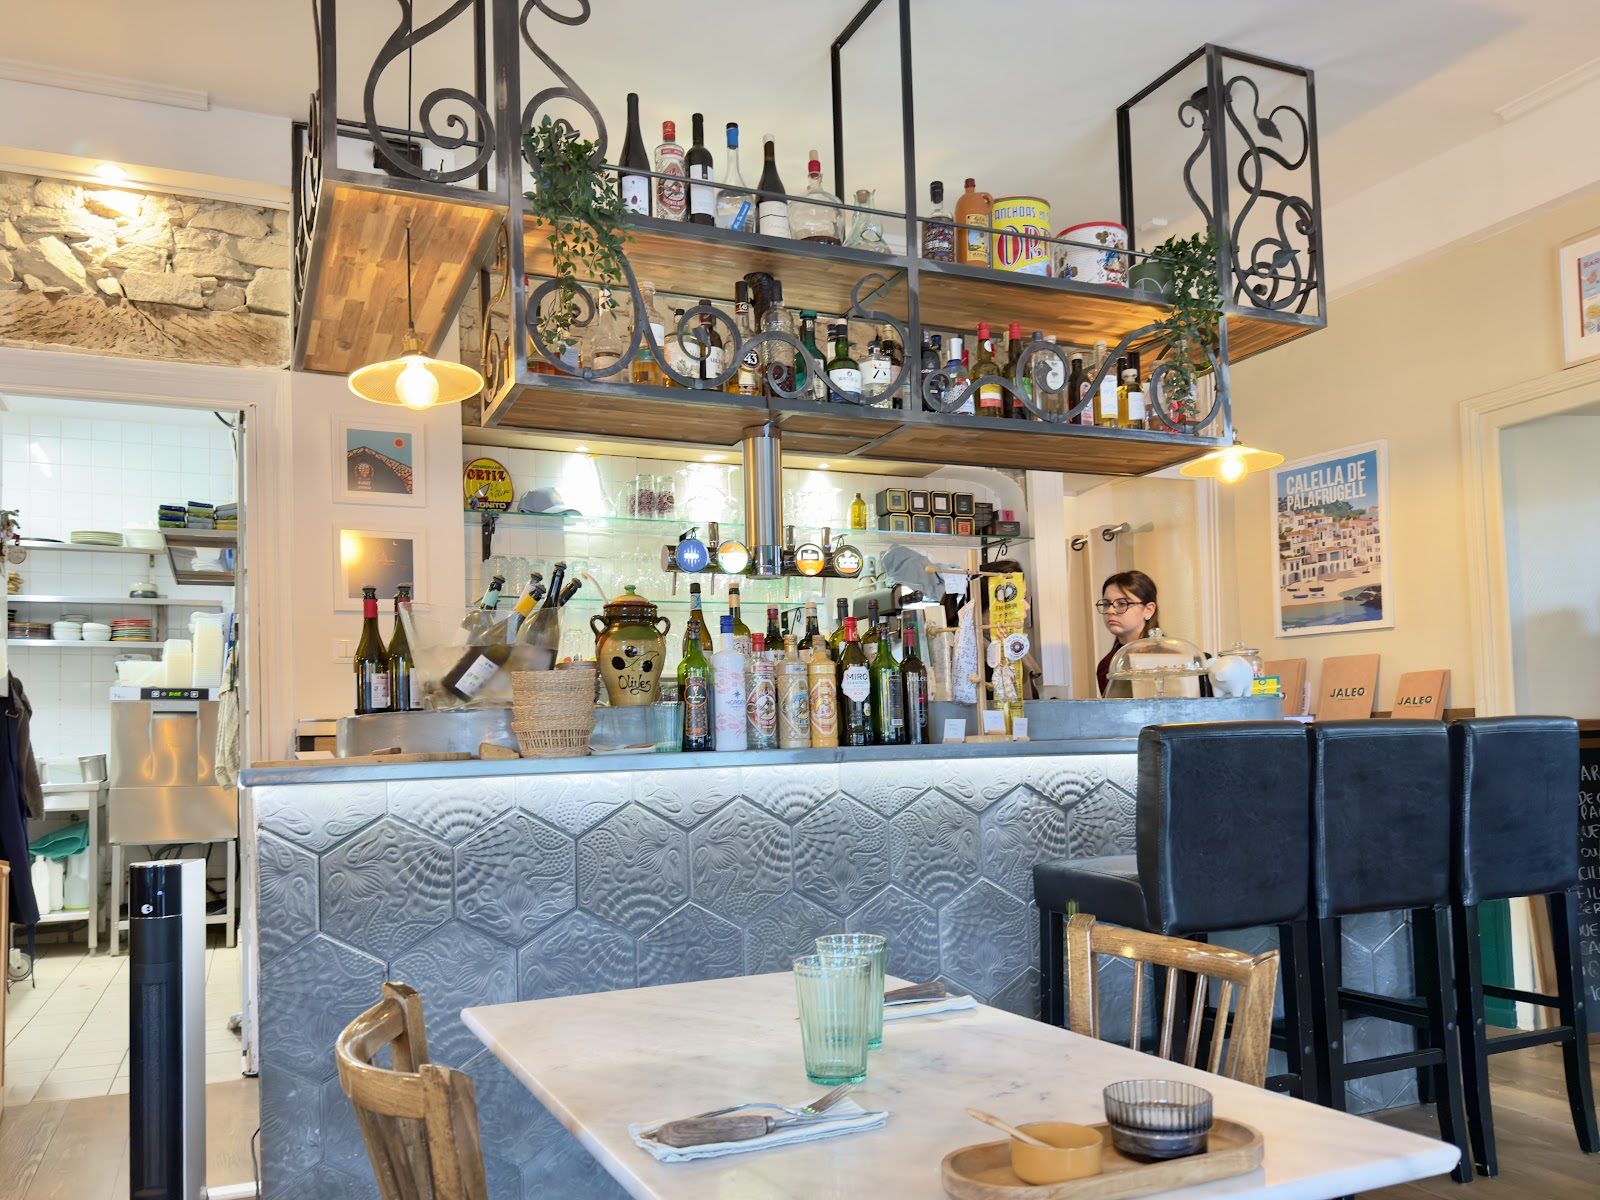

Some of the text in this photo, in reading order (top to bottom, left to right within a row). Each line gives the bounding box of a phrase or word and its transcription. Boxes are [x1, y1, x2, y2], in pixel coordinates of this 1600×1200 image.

[994, 206, 1036, 220] ANCHOAS
[744, 352, 758, 365] 43
[466, 469, 506, 481] ORTIZ
[1286, 460, 1366, 495] CALELLA DE
[1287, 481, 1366, 511] PALAFRUGELL
[1330, 687, 1365, 697] JALEO
[1397, 695, 1432, 705] JALEO
